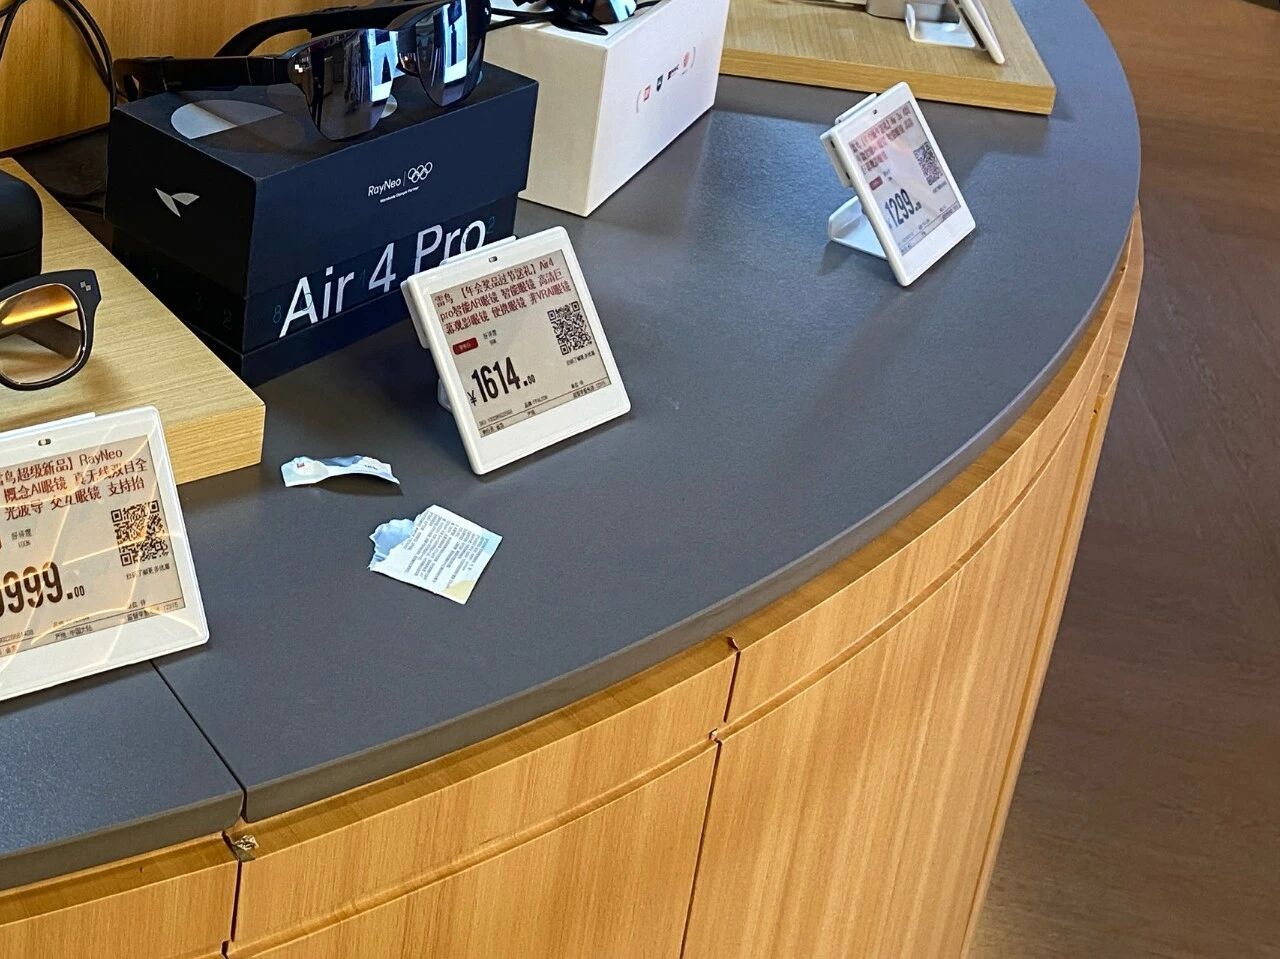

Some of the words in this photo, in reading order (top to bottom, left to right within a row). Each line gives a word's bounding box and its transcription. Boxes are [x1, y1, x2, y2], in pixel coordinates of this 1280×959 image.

[368, 178, 401, 196] RayNeo
[279, 266, 355, 338] Air
[368, 242, 397, 292] 4
[413, 219, 487, 275] Pro
[78, 445, 123, 467] RayNeo
[106, 474, 145, 497] 支持抬
